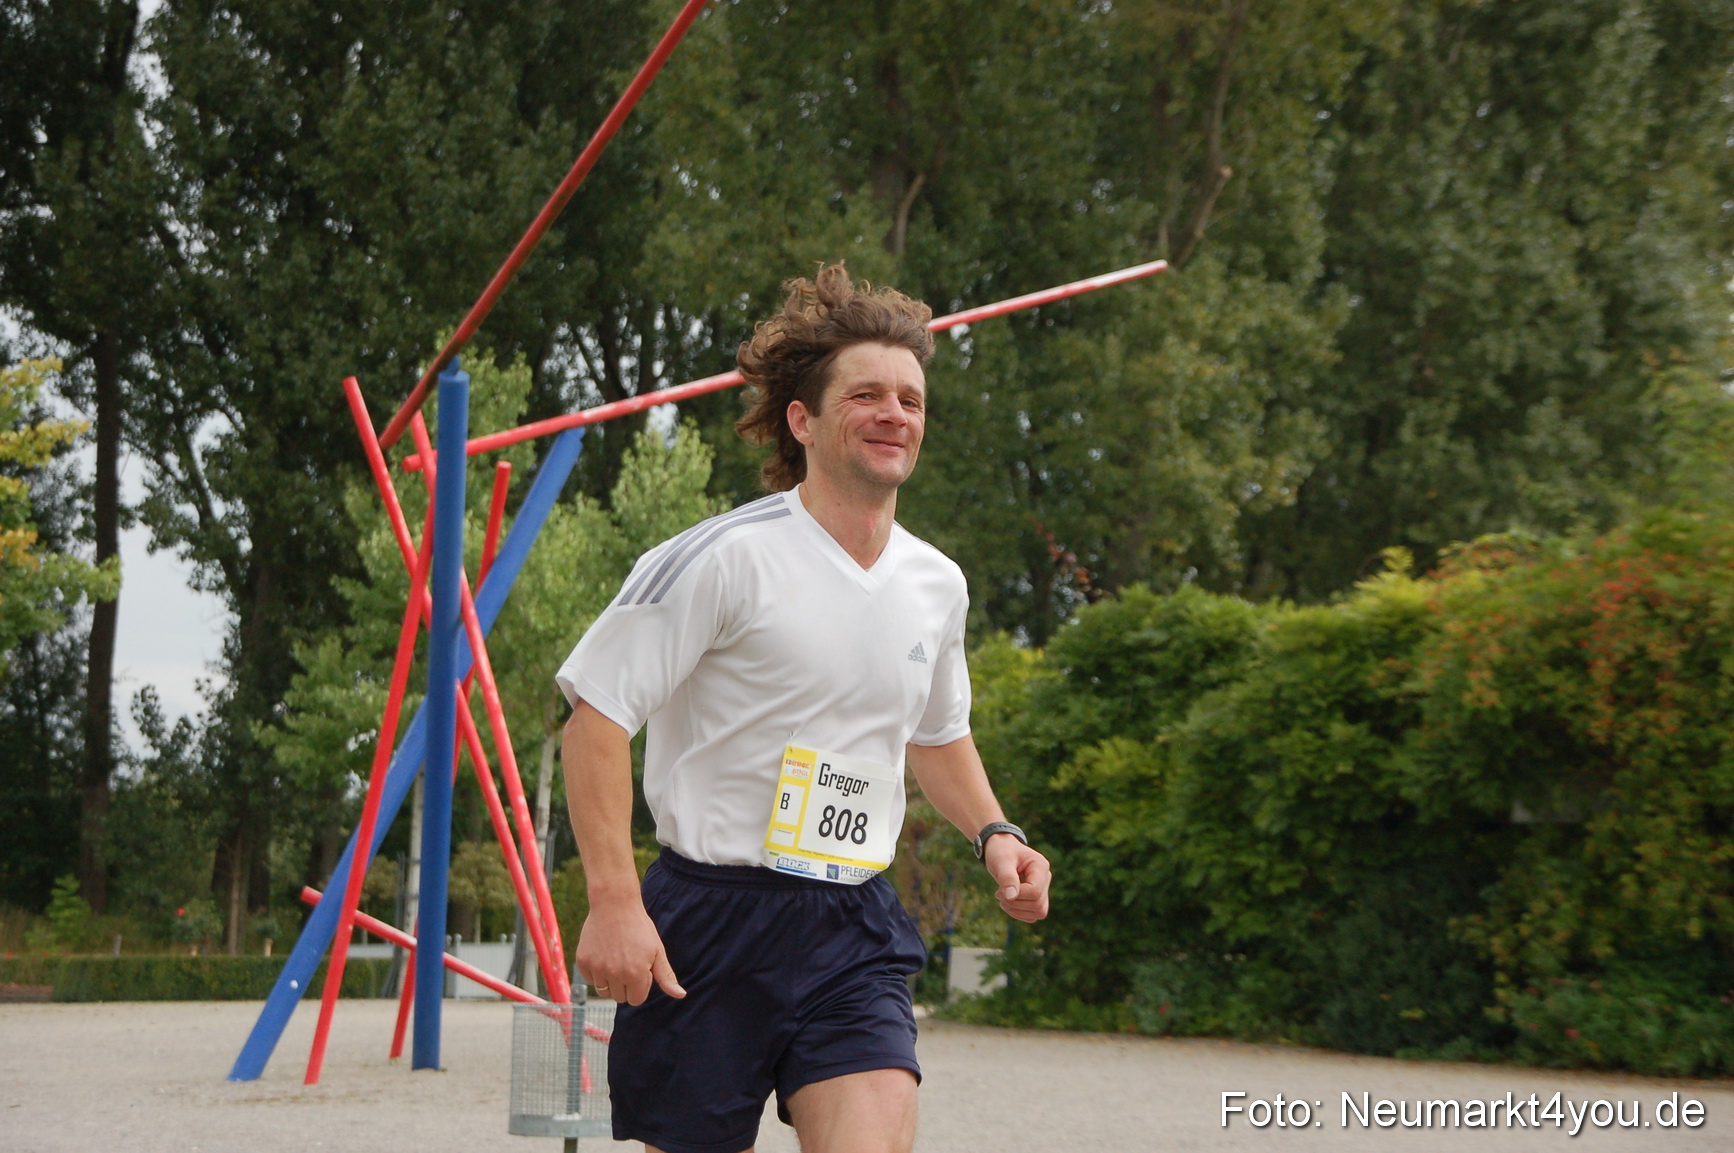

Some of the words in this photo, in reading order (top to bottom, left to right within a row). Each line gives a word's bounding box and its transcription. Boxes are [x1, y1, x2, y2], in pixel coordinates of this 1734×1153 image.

[818, 763, 869, 797] Gregor
[780, 792, 790, 810] B
[818, 805, 868, 845] 808
